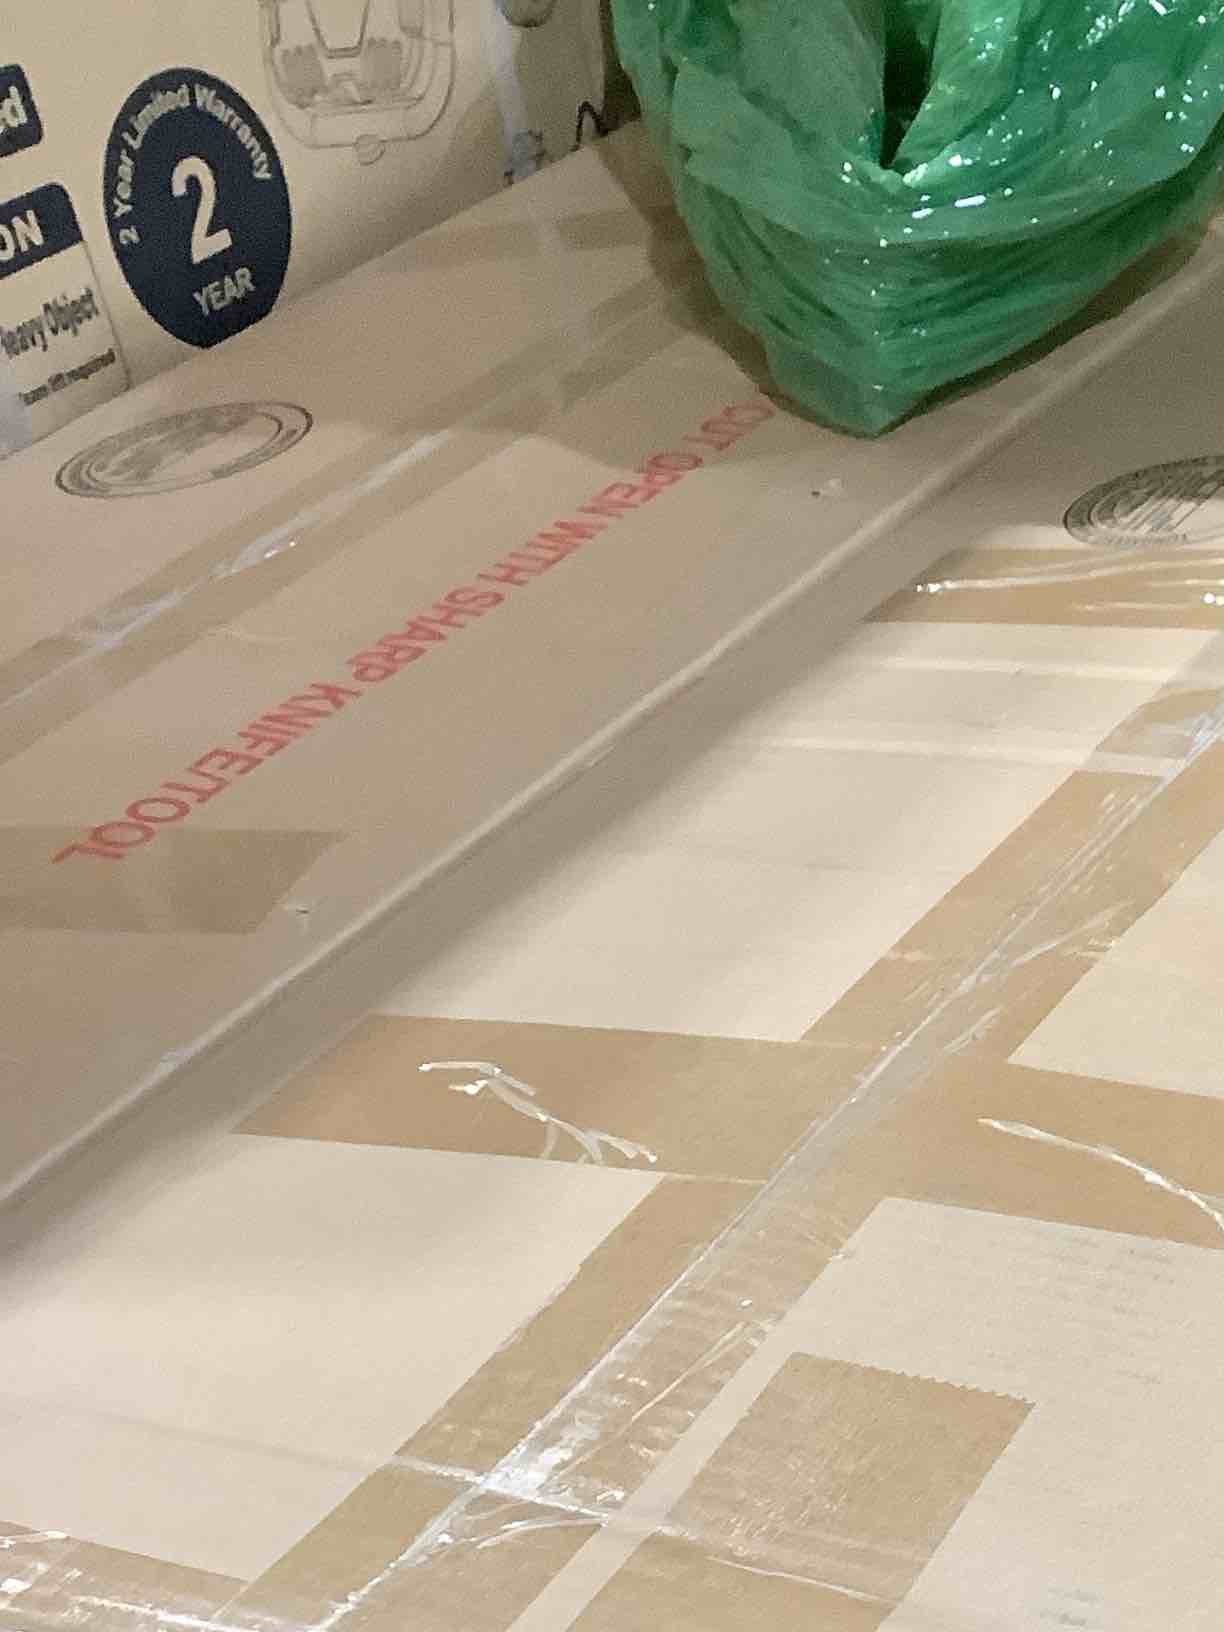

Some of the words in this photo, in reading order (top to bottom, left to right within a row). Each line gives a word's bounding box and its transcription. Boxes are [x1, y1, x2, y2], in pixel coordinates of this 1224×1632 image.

[121, 83, 190, 150] Limited
[194, 83, 272, 179] Warranty
[113, 150, 135, 217] Year
[172, 155, 232, 265] 2
[193, 266, 256, 316] YEAR
[681, 400, 776, 451] CUT
[578, 451, 704, 519] OPEN
[477, 519, 611, 587] WITH
[346, 585, 504, 684] SHARP
[52, 680, 362, 866] KNIFE/TOOL
